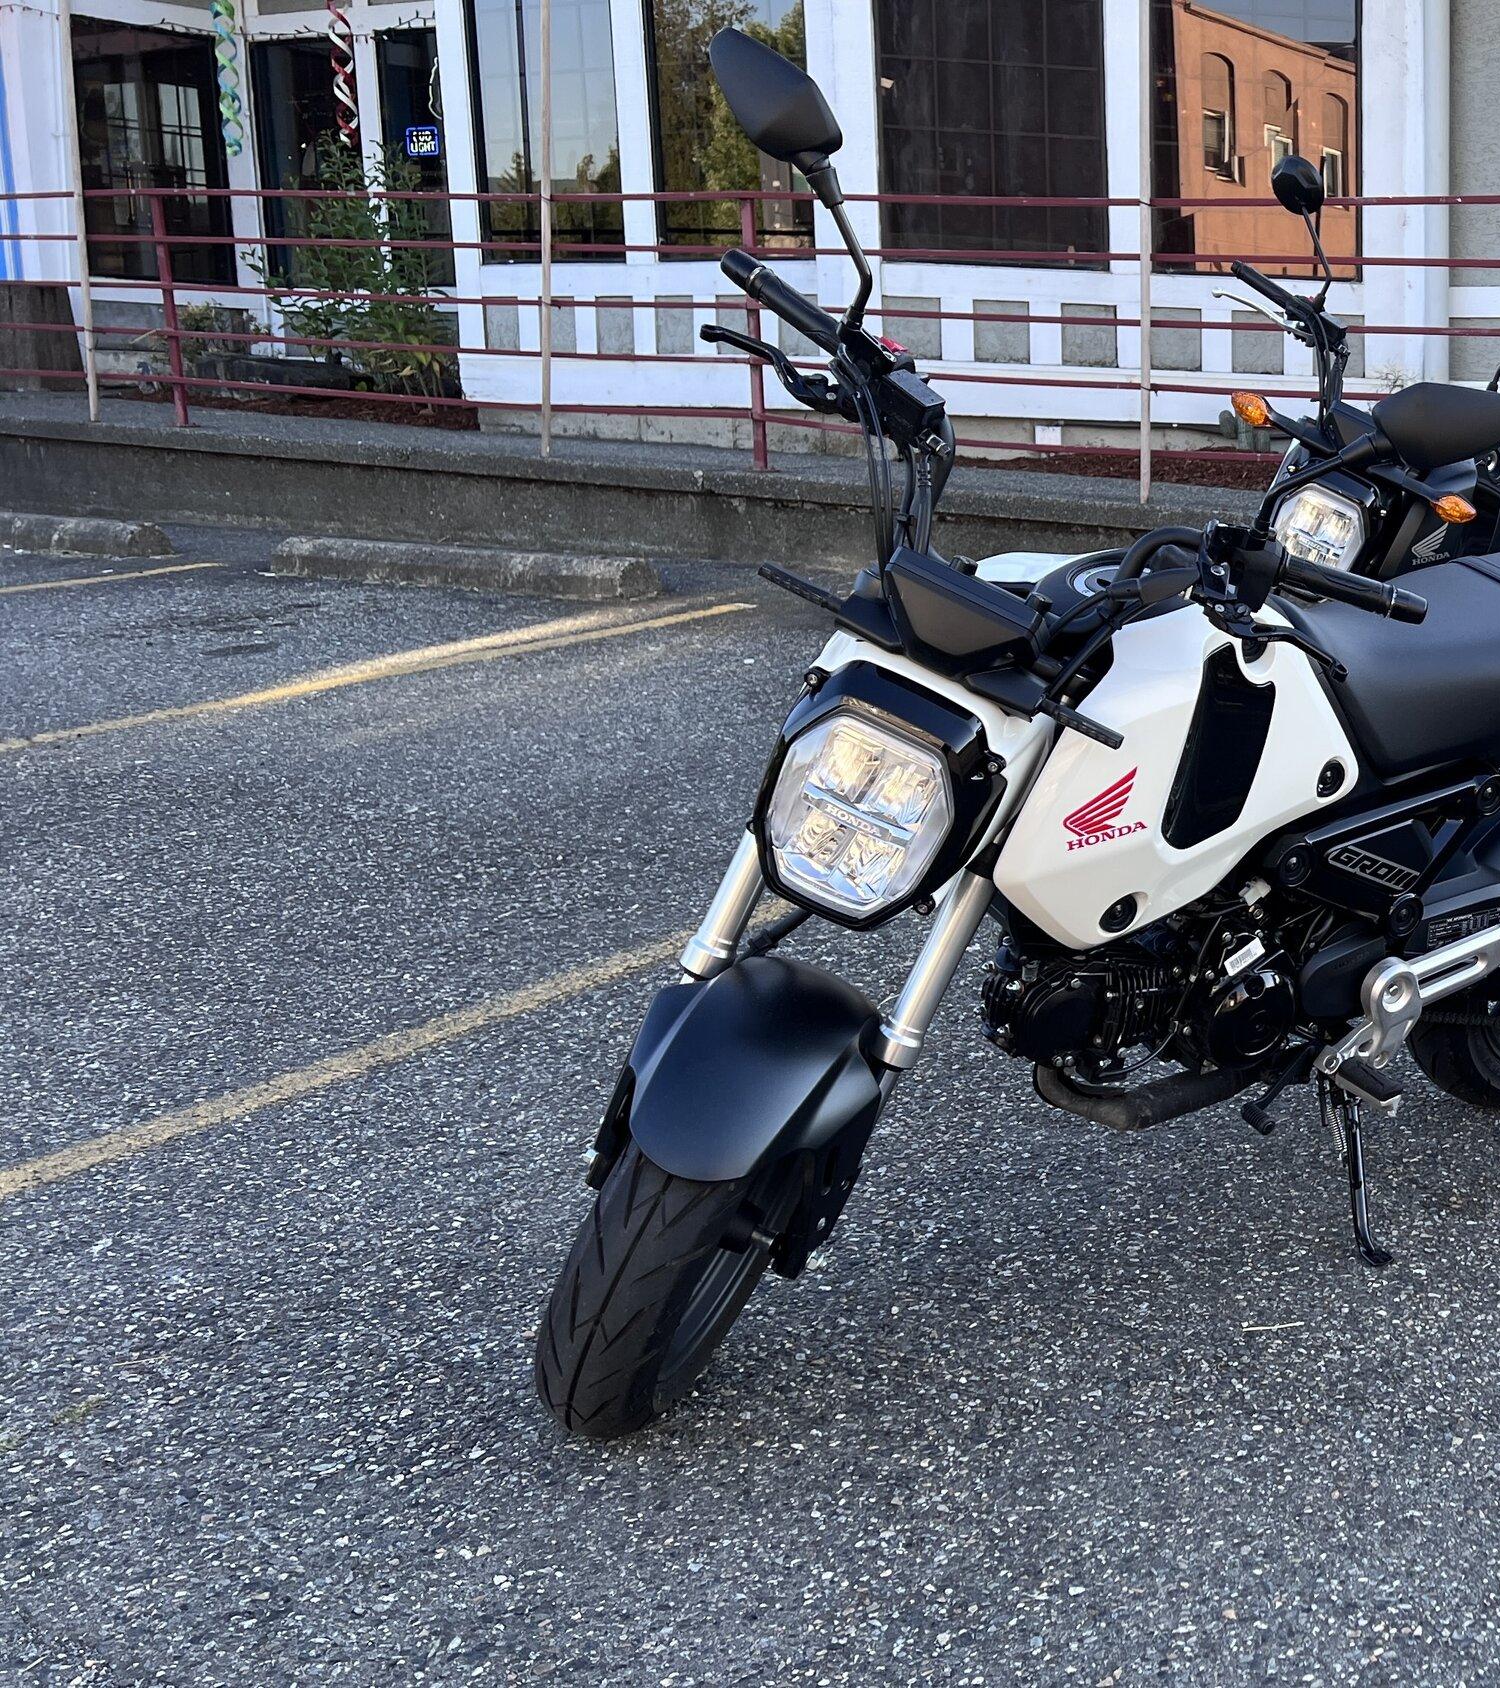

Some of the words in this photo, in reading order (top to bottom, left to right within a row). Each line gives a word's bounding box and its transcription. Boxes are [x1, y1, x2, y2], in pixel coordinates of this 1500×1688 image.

[410, 141, 436, 153] LIGHT
[1411, 551, 1450, 566] HONDA
[824, 802, 882, 837] HONDA
[1066, 821, 1148, 851] HONDA
